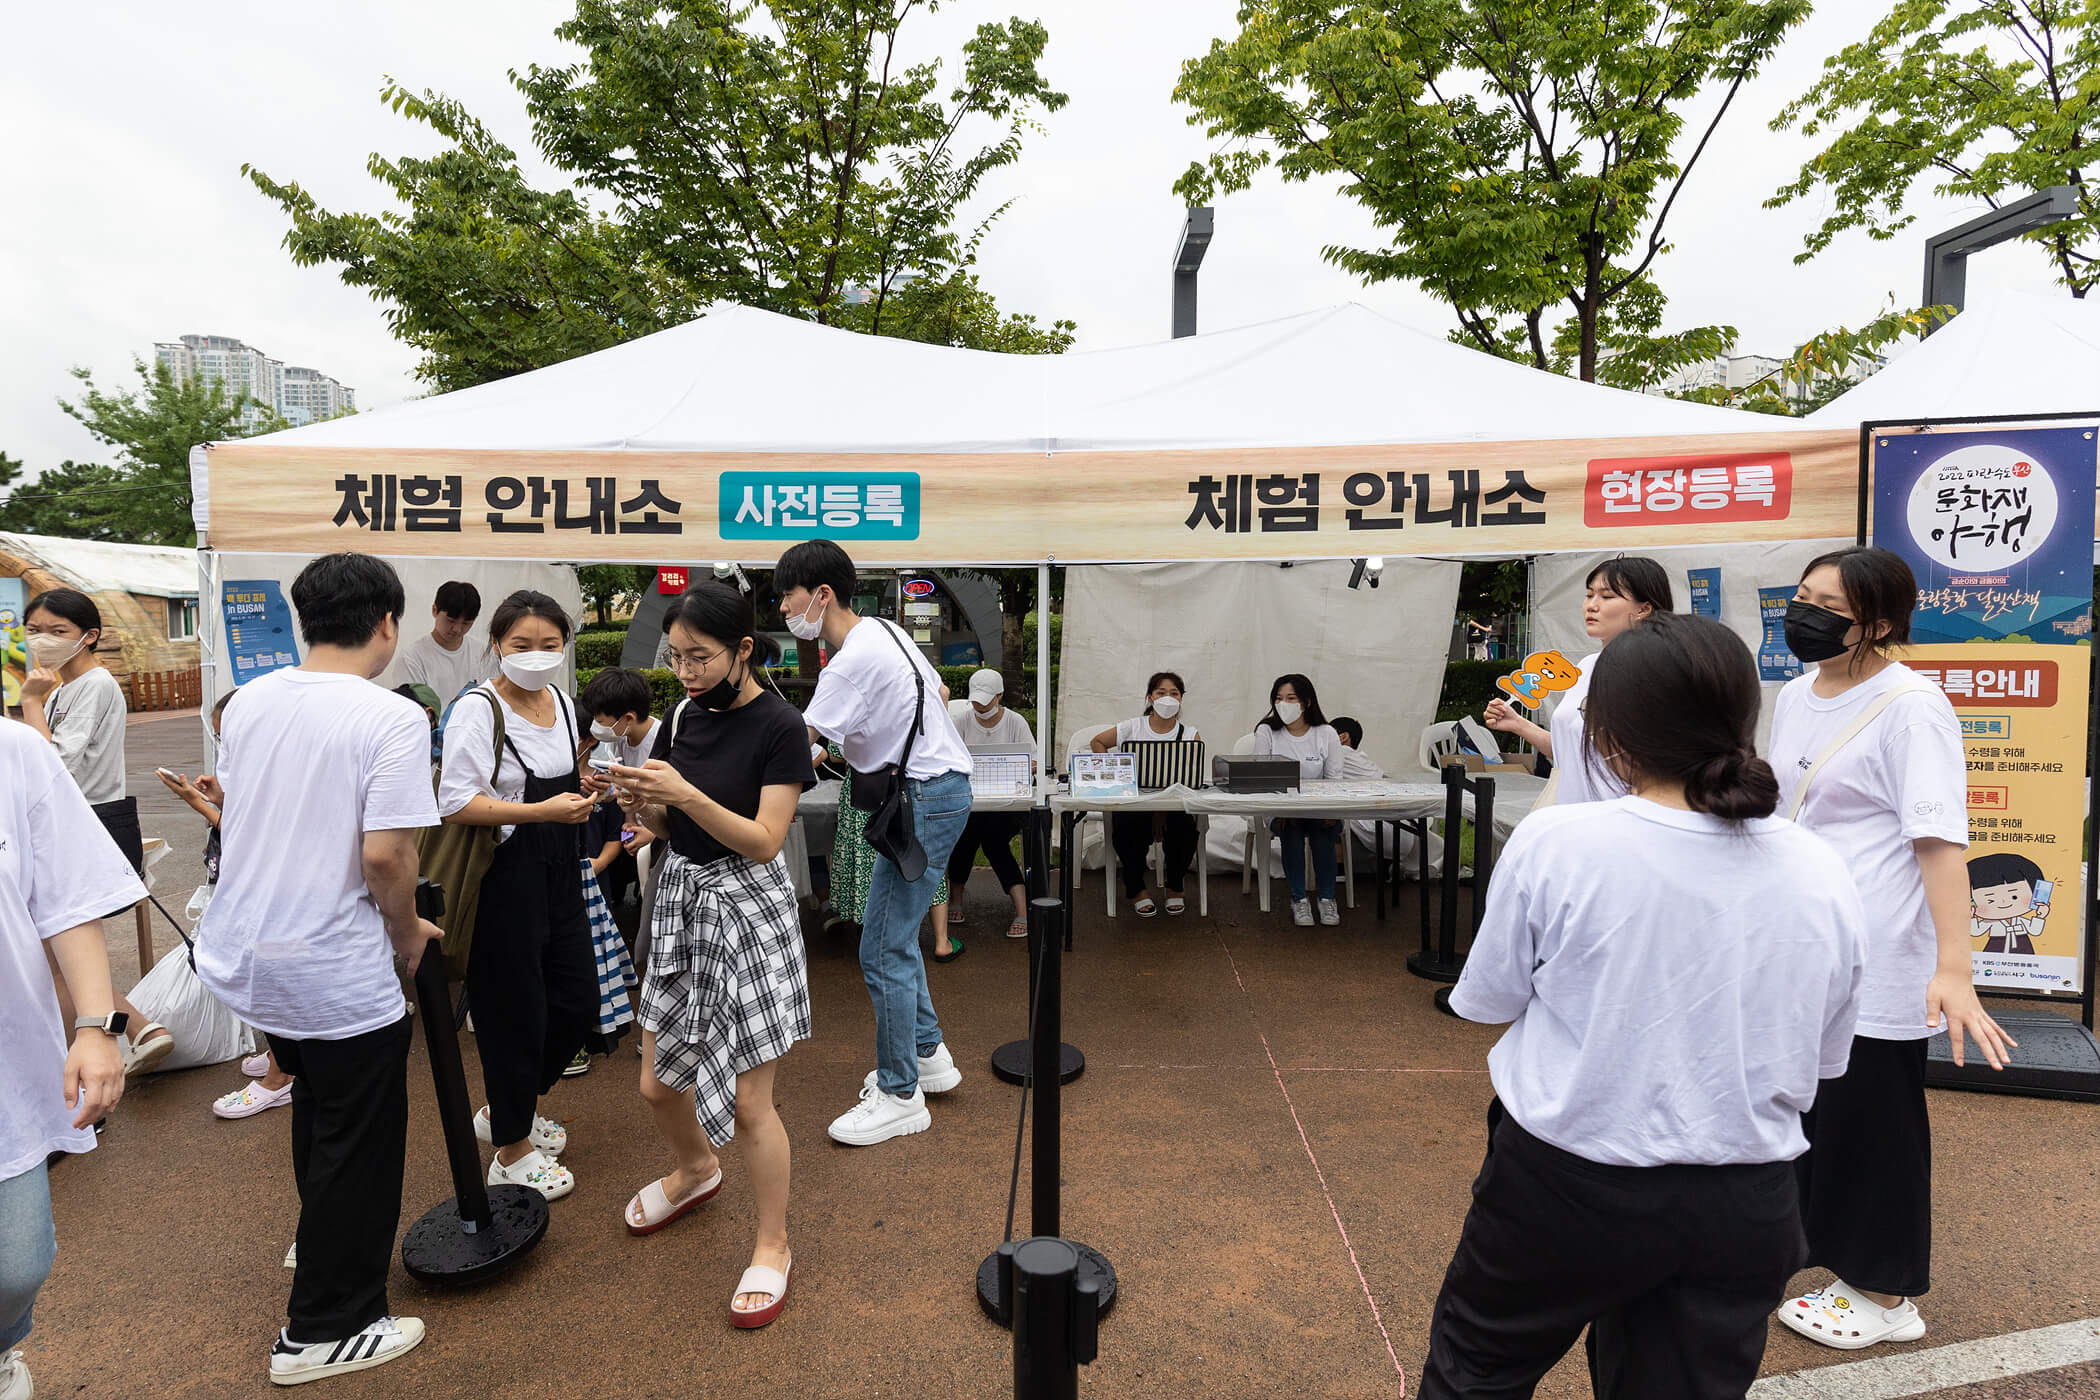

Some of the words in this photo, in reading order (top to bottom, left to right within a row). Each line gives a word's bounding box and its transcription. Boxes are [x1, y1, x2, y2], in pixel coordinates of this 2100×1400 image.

[1938, 472, 1964, 481] 2022
[1966, 467, 2011, 480] 피란수도
[331, 473, 462, 533] 체험
[484, 475, 683, 534] 안내소
[734, 483, 906, 528] 사전등록
[1185, 473, 1320, 534] 체험
[1342, 469, 1546, 530] 안내소
[1601, 464, 1777, 514] 현장등록
[1936, 484, 2028, 513] 문화재
[1931, 505, 2032, 559] 야행
[905, 583, 932, 593] OPEN
[227, 604, 236, 614] in
[236, 602, 265, 614] BUSAN
[1969, 748, 2000, 758] 수령을
[2003, 748, 2025, 758] 위해
[1998, 762, 2063, 773] 준비해주세요
[1968, 818, 1998, 828] 수령을
[2001, 819, 2023, 828] 위해
[1991, 832, 2056, 844] 준비해주세요
